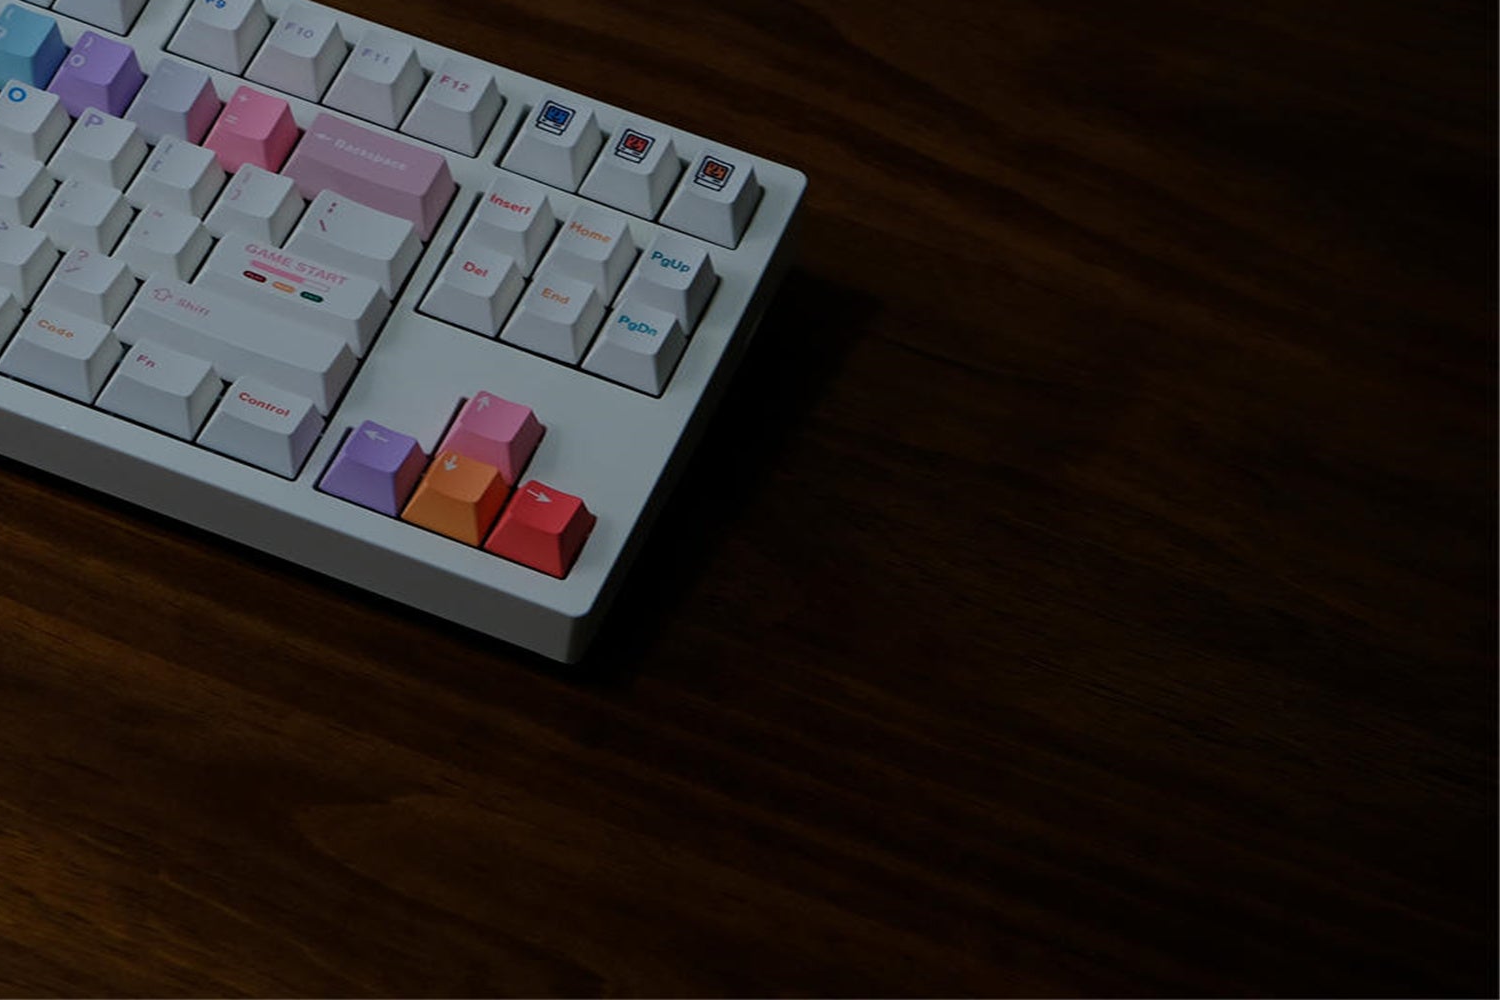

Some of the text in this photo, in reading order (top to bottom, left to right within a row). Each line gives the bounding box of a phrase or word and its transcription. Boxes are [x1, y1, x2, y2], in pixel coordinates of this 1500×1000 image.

[283, 22, 314, 39] F10
[361, 47, 390, 65] F11
[439, 75, 470, 93] F12
[8, 87, 27, 102] O
[84, 113, 104, 128] P
[489, 193, 532, 216] Insert
[568, 221, 613, 244] Home
[244, 243, 348, 286] GAME START
[462, 262, 489, 278] Del
[650, 250, 691, 275] PgUp
[540, 287, 571, 305] End
[177, 298, 212, 317] Shift
[38, 319, 76, 339] Code
[617, 314, 659, 338] PgDn
[135, 354, 156, 369] Fn
[239, 391, 290, 418] Control
